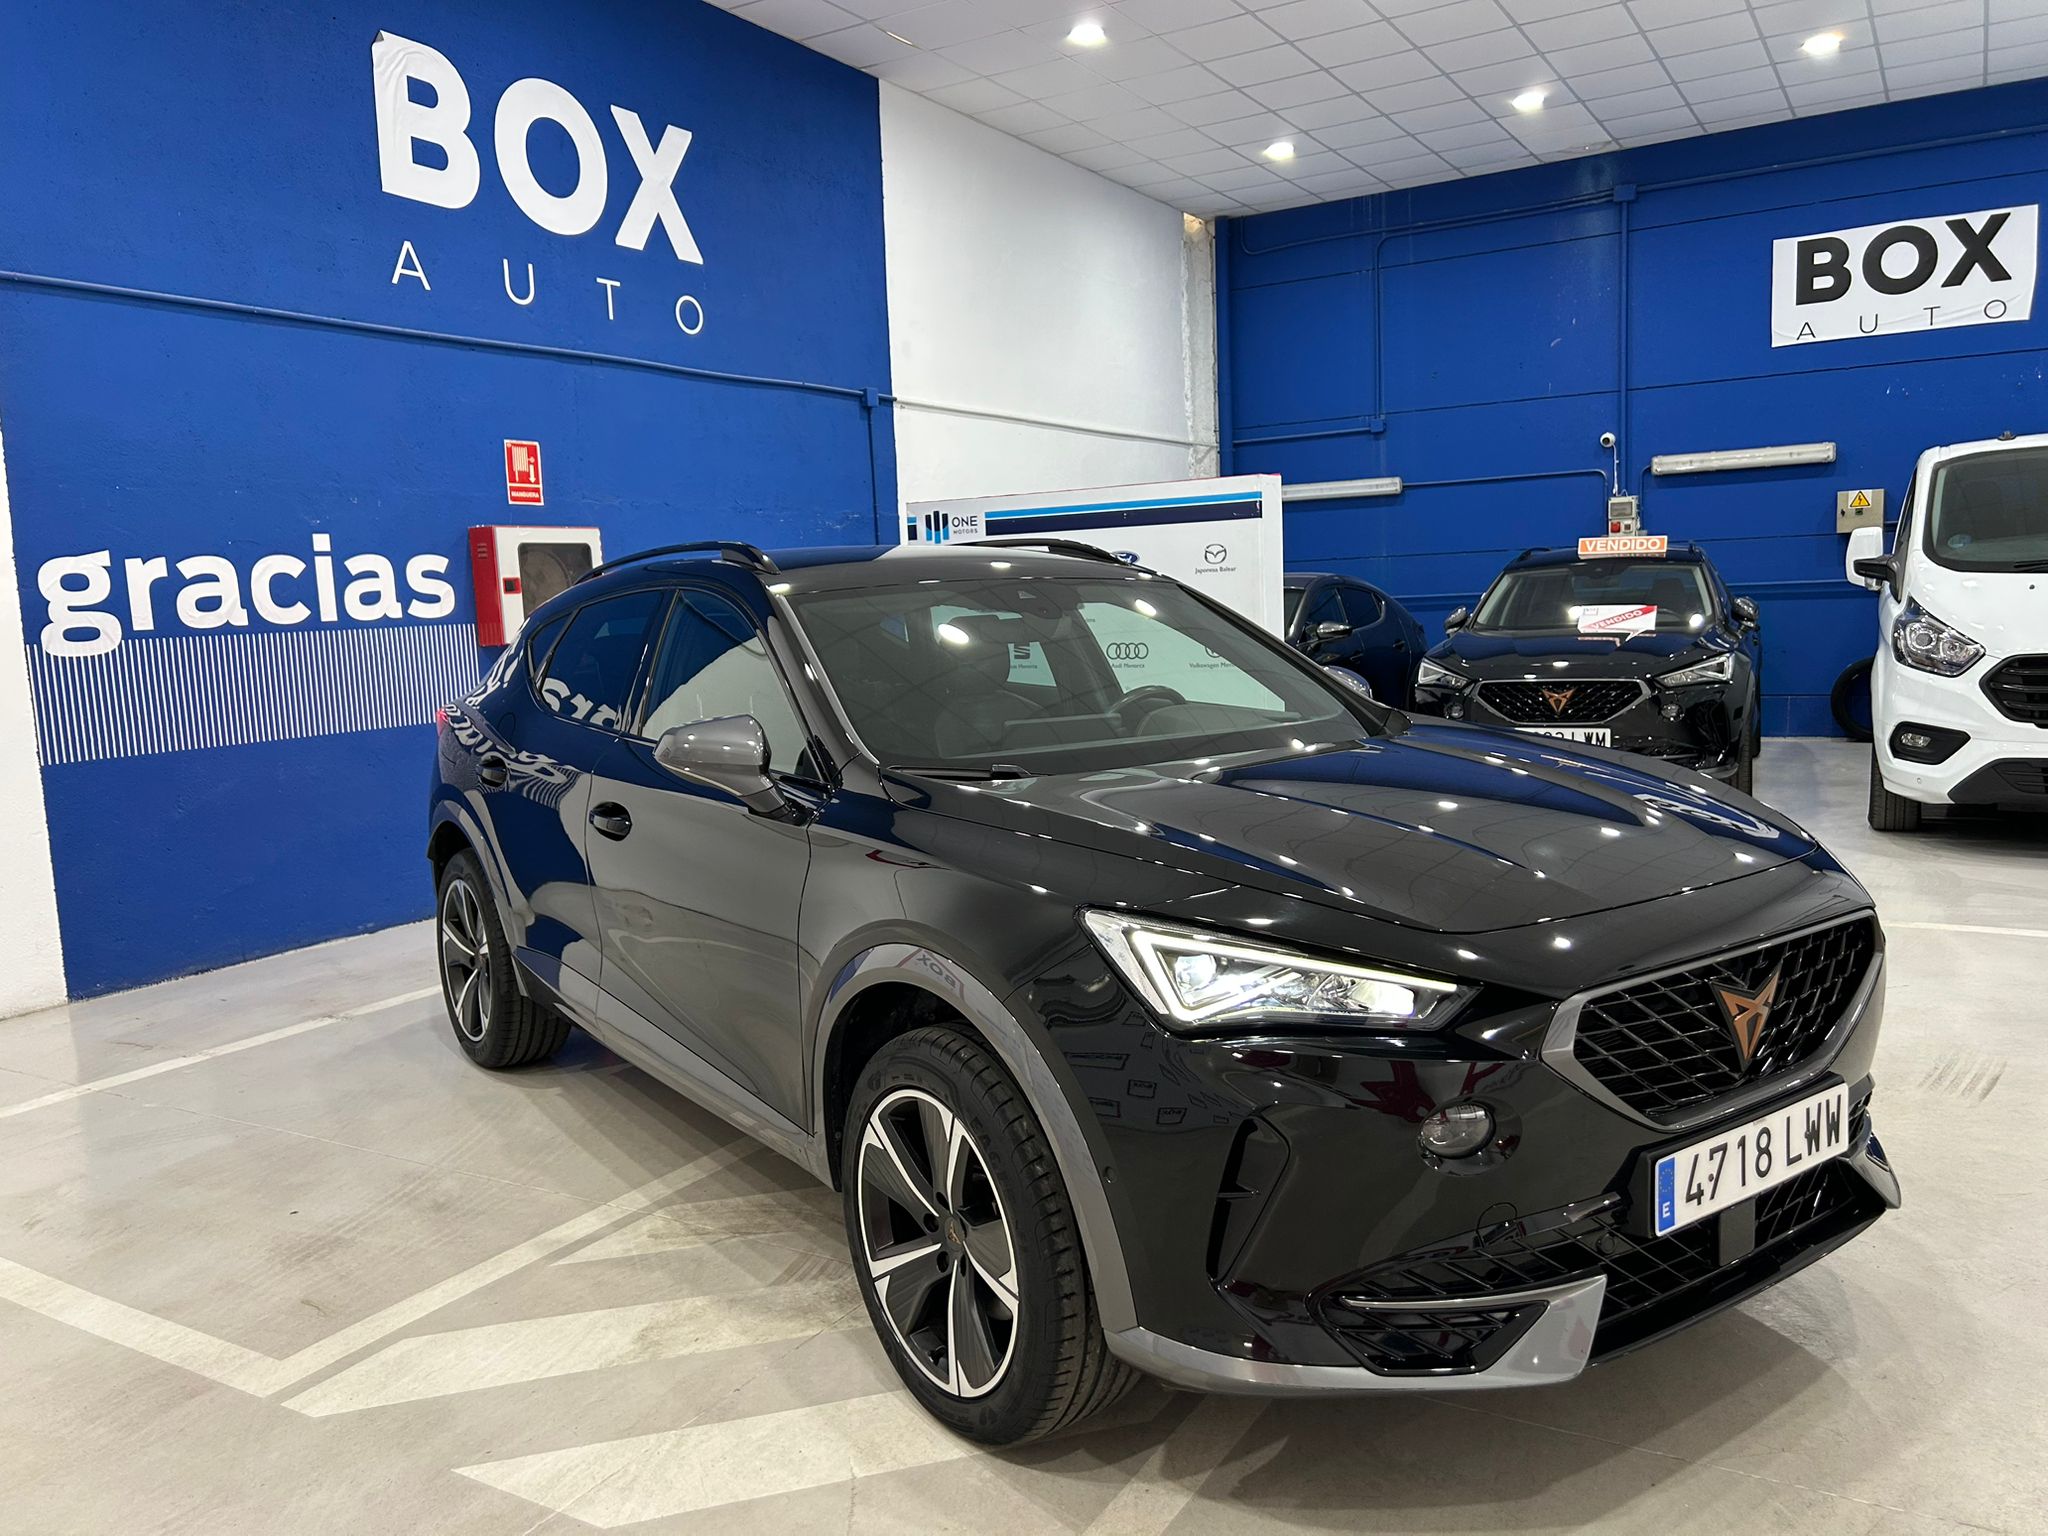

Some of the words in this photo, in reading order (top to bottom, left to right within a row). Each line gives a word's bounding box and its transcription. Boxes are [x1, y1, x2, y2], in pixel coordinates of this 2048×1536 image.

[372, 29, 703, 266] BOX
[391, 240, 703, 336] AUTO
[1795, 212, 2012, 306] BOX
[1796, 299, 2007, 341] AUTO
[952, 515, 978, 527] ONE
[1585, 538, 1661, 551] VENDIDO
[37, 533, 456, 657] gracias
[1590, 609, 1643, 629] VENDIDO
[1685, 1126, 1773, 1206] 4718
[1785, 1094, 1842, 1168] LWW
[1662, 1202, 1671, 1218] E
